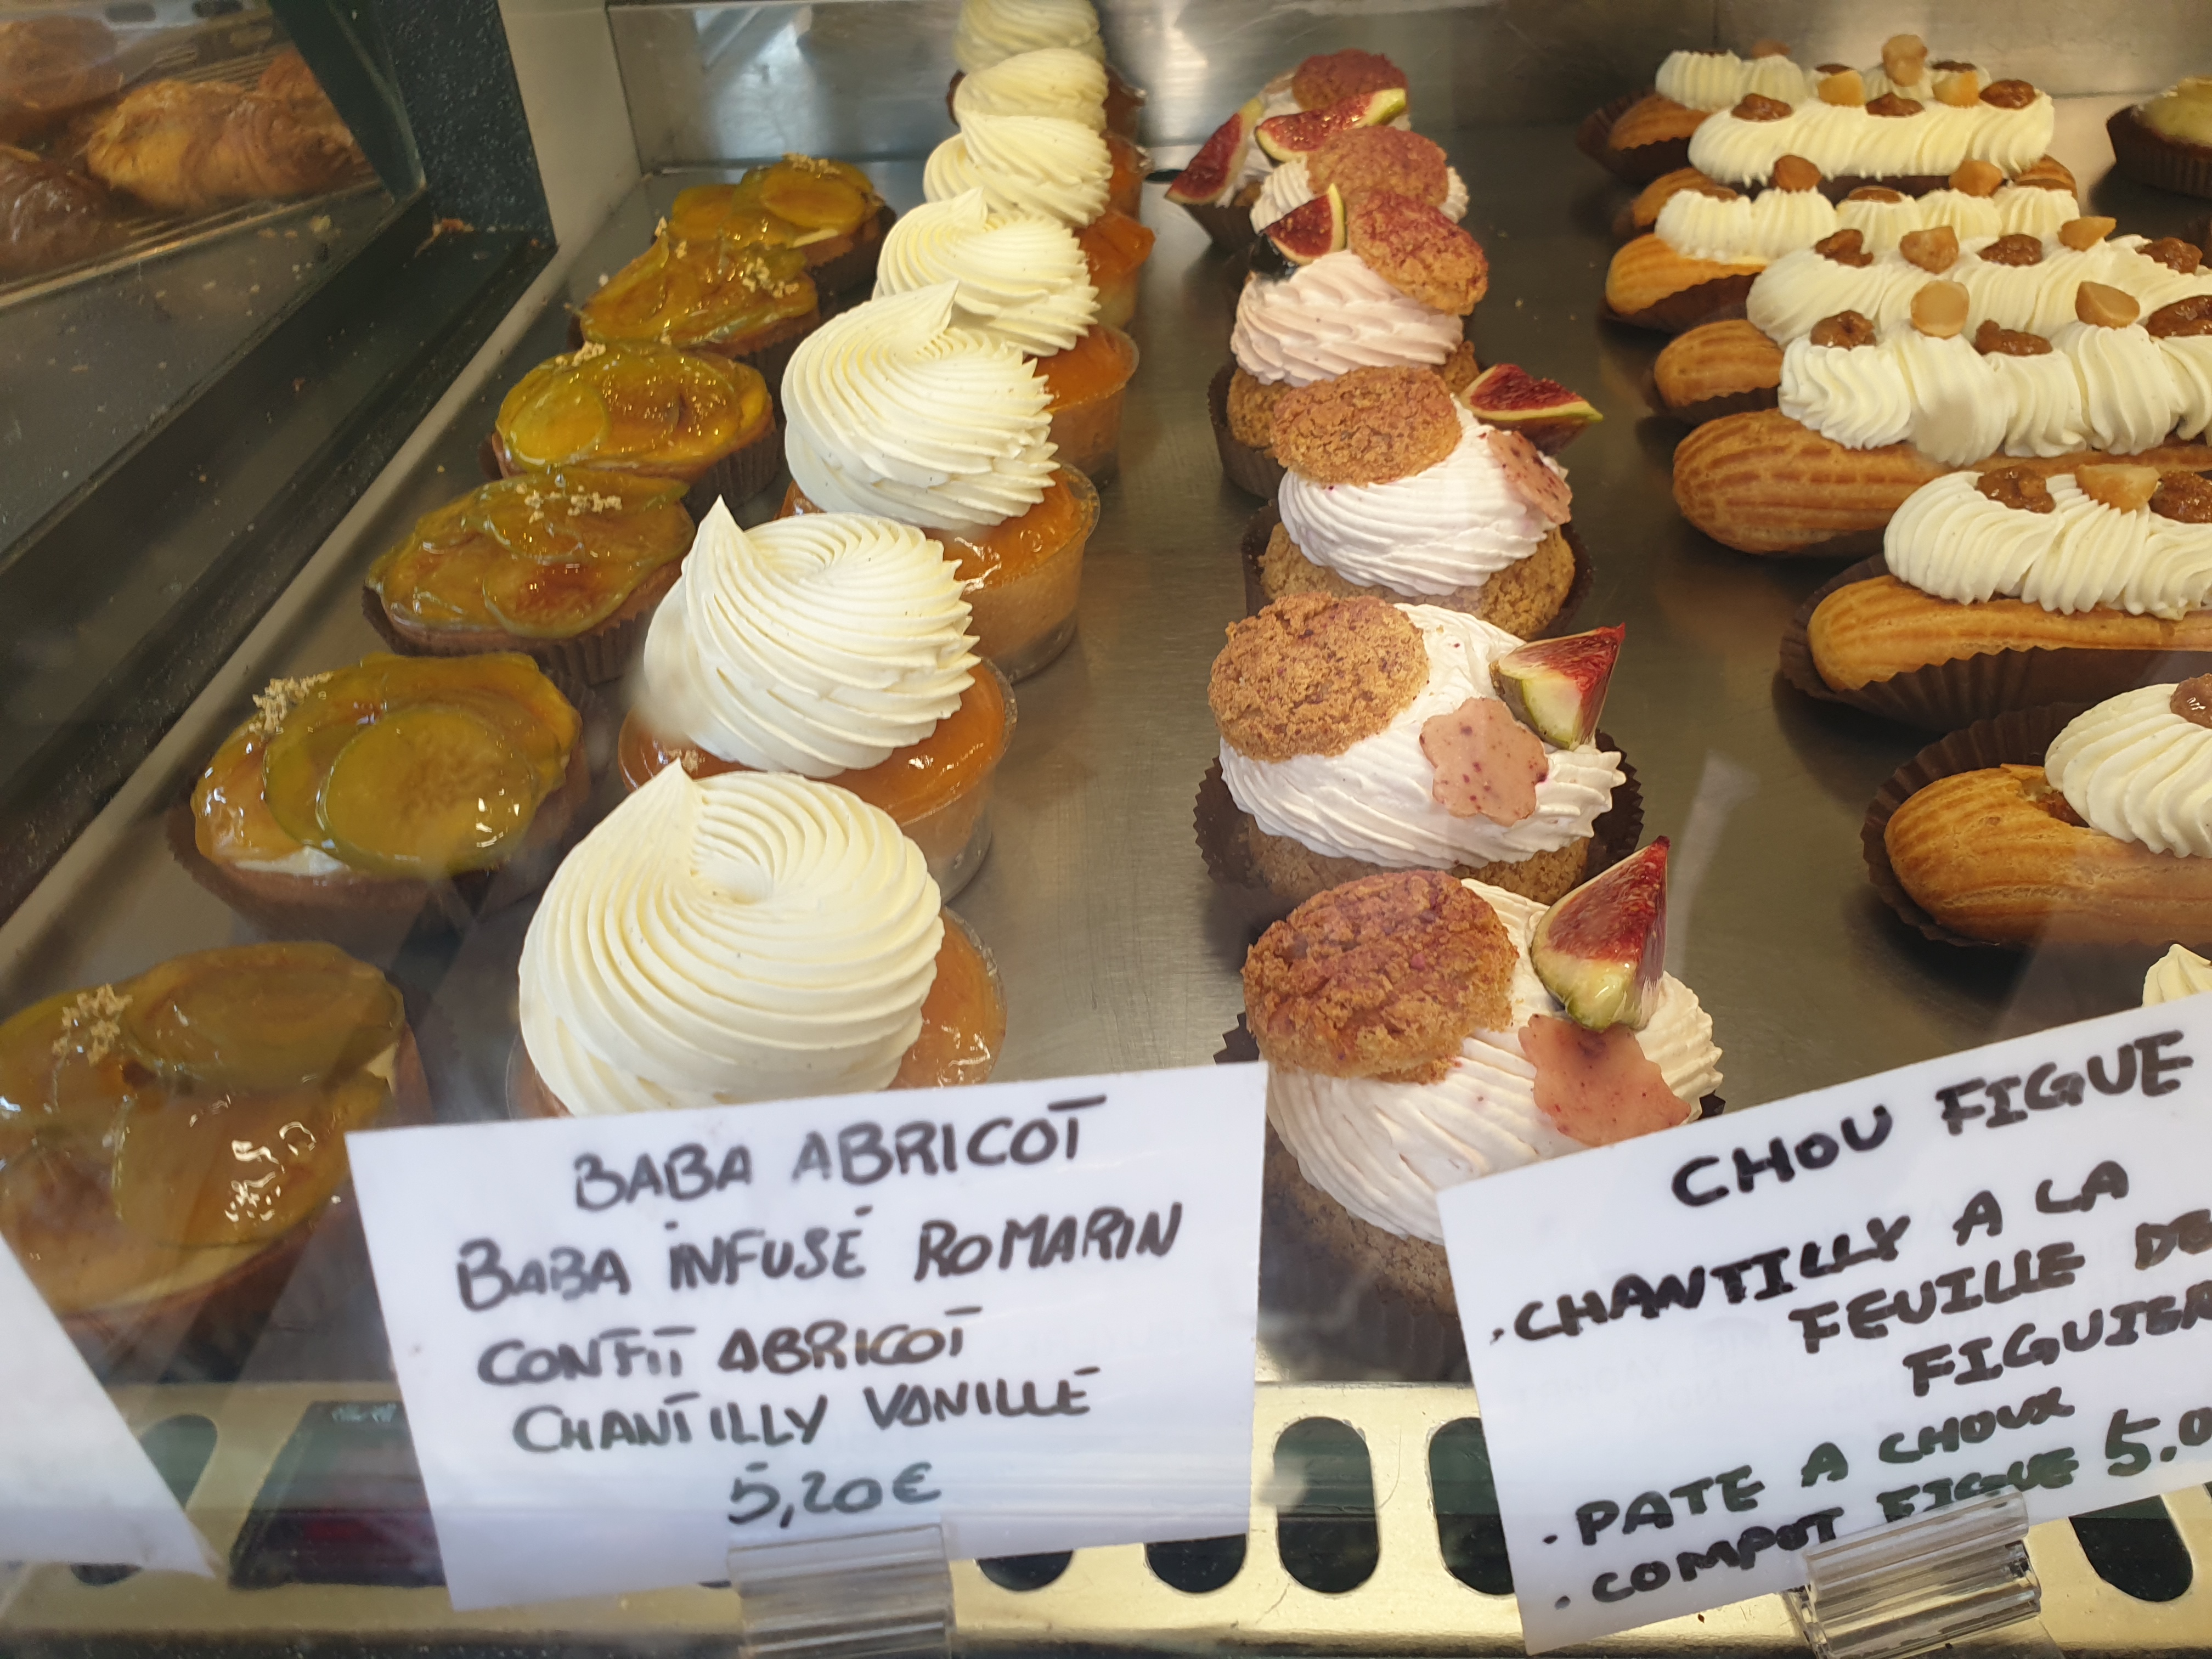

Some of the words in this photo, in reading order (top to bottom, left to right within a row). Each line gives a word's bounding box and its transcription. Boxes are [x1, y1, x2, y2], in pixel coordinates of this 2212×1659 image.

[575, 1144, 751, 1211] BABA
[792, 1096, 1106, 1184] ABRICOT
[1672, 1104, 1893, 1207] CHOU
[1935, 1030, 2194, 1136] FIGUE
[1953, 1190, 2002, 1246] A
[2035, 1160, 2129, 1214] LA
[458, 1239, 630, 1311] BABA
[914, 1202, 1182, 1282] ROMARIN
[1788, 1242, 2085, 1354] FEUILLE
[478, 1327, 696, 1385] CONFIT
[718, 1307, 981, 1374] ABRICOT
[514, 1393, 827, 1452] CHANTILLY
[1801, 1441, 1848, 1488] A
[1878, 1386, 2075, 1464] CHOUX
